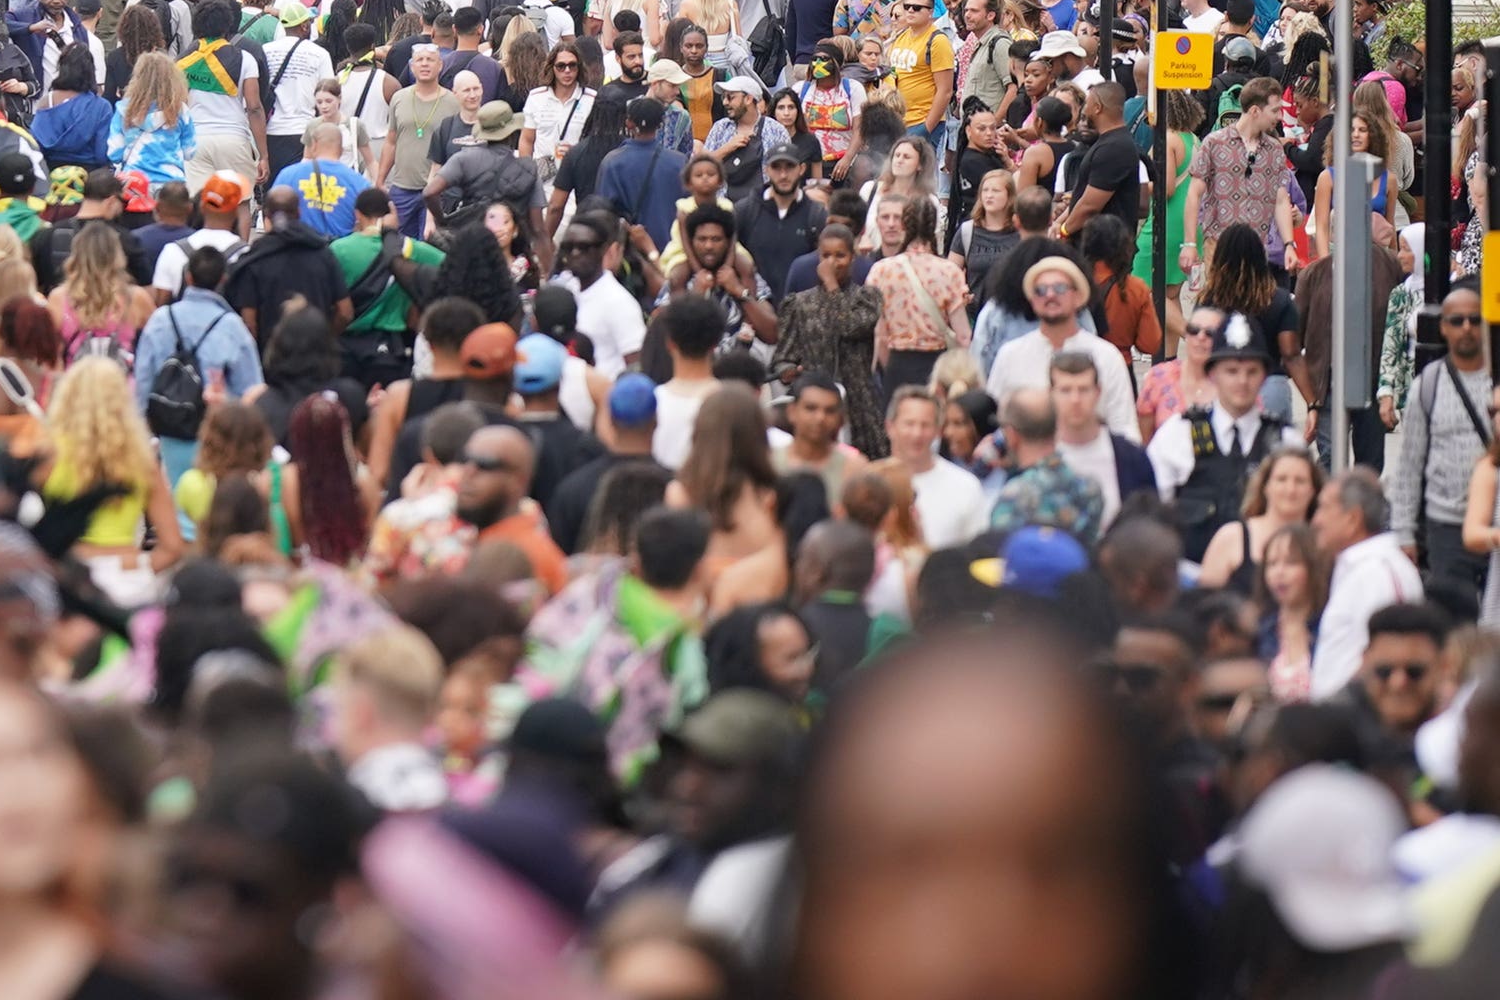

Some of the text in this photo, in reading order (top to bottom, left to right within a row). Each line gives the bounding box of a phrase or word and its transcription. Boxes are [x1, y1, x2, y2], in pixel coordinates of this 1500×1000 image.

[1170, 61, 1197, 72] Parking
[185, 73, 211, 85] AMAICA
[1162, 71, 1204, 81] Suspension
